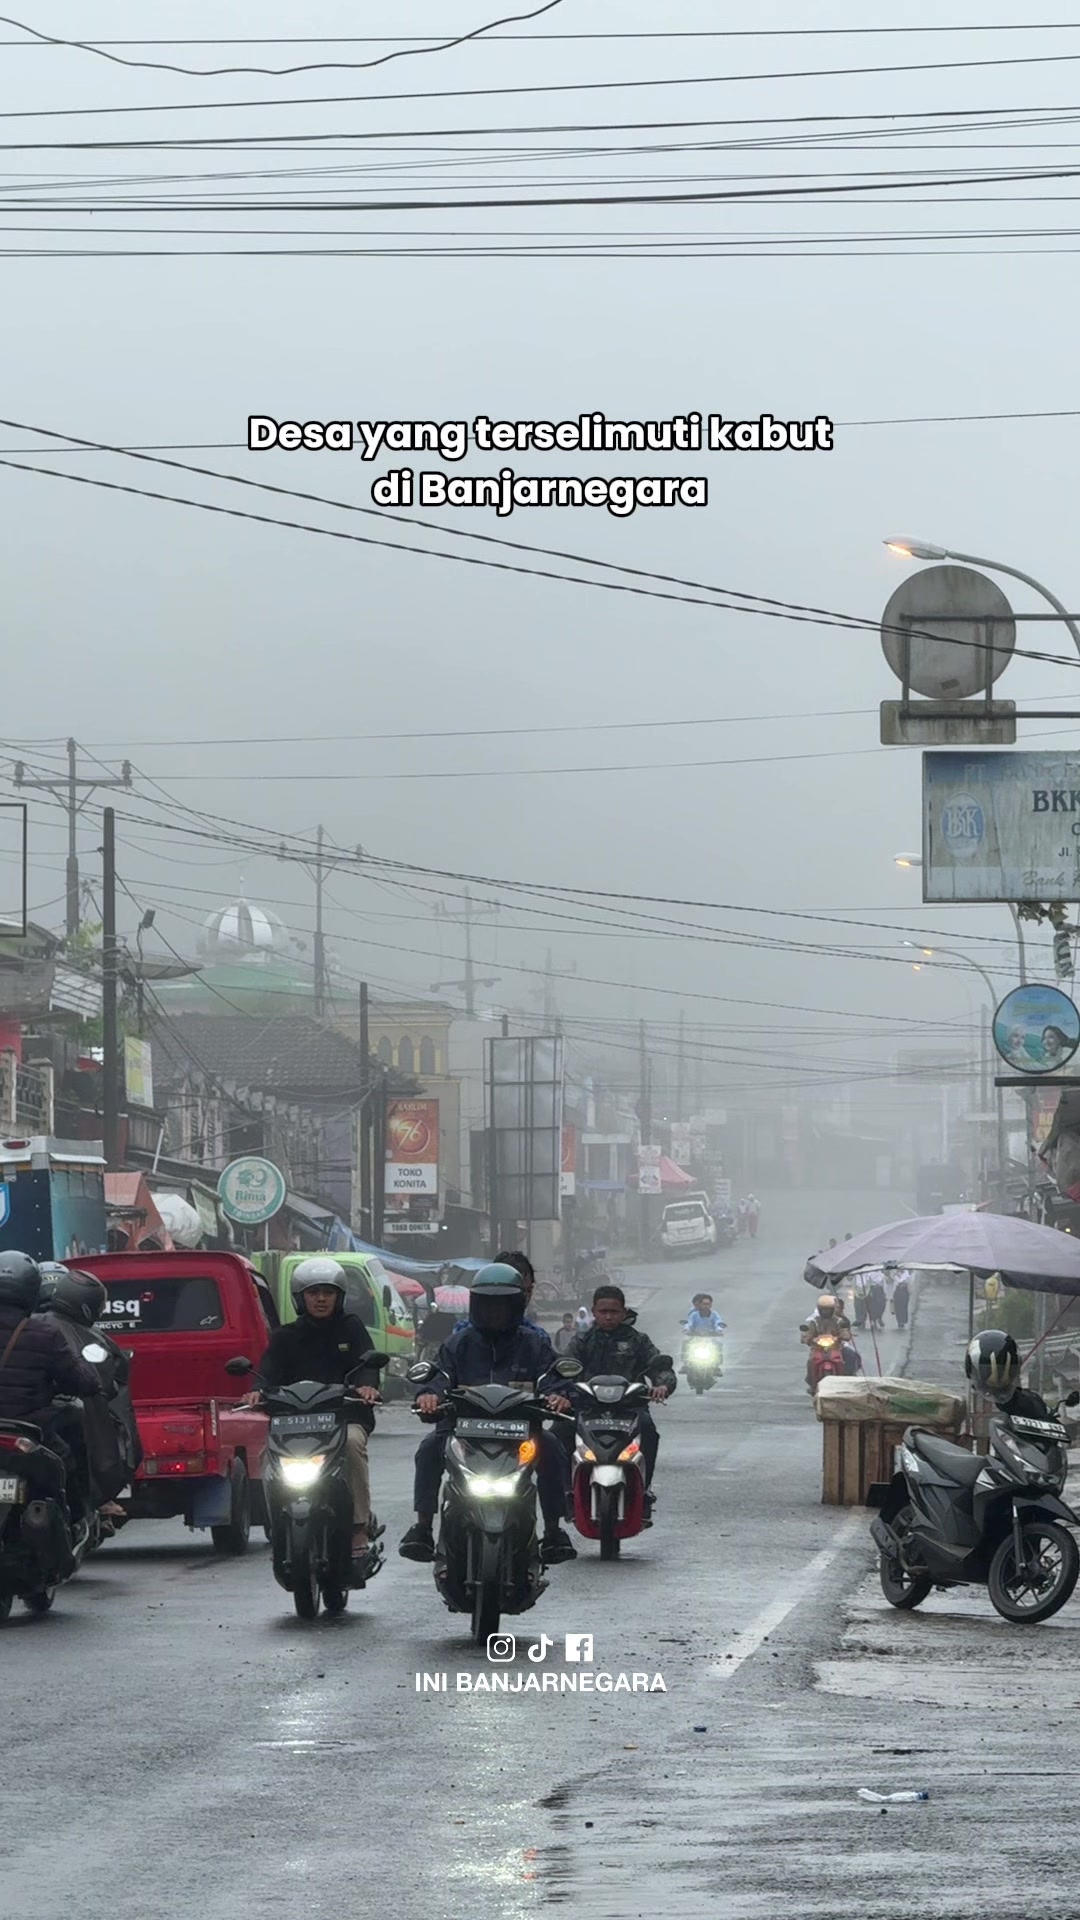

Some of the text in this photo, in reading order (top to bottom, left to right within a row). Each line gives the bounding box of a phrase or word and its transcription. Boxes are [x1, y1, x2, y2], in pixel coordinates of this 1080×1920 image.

[399, 1119, 422, 1146] 76
[398, 1168, 422, 1177] TOKO
[393, 1180, 427, 1188] KONITA
